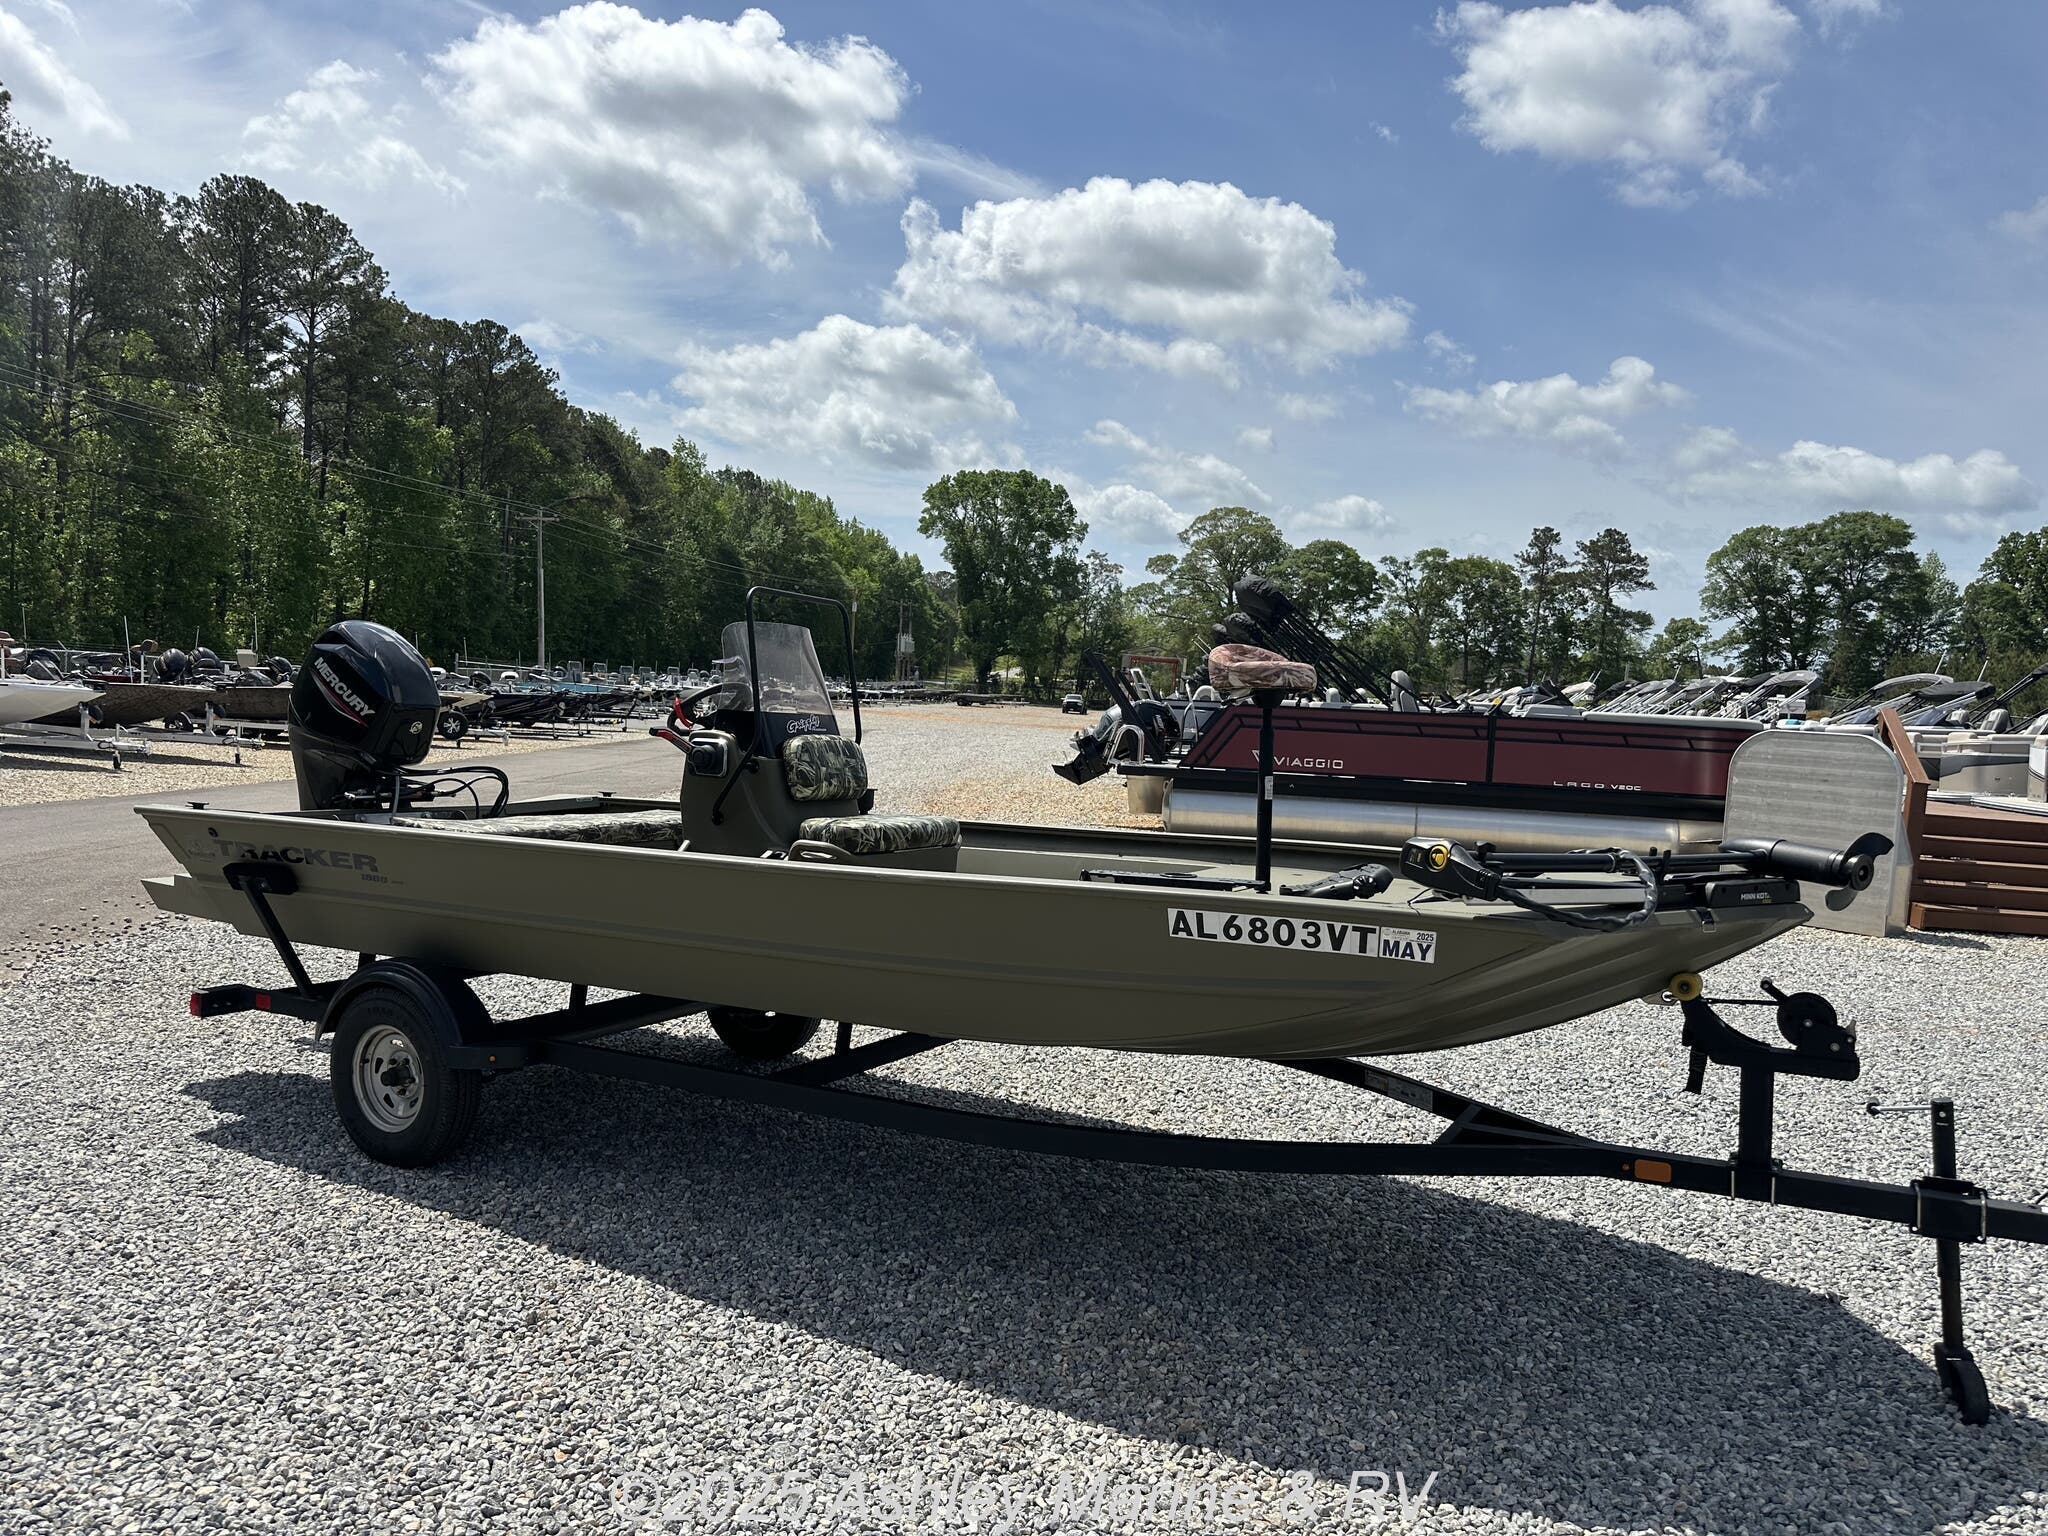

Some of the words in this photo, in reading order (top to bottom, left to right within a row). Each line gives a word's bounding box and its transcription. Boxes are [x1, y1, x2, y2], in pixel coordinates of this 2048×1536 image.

[314, 657, 376, 716] MERCURY
[1273, 756, 1344, 769] VIAGGIO
[1553, 780, 1605, 789] LAGO
[212, 838, 379, 872] TRACKER
[1171, 910, 1377, 955] AL6803VT
[1416, 932, 1434, 942] 2025
[1382, 939, 1432, 961] MAY
